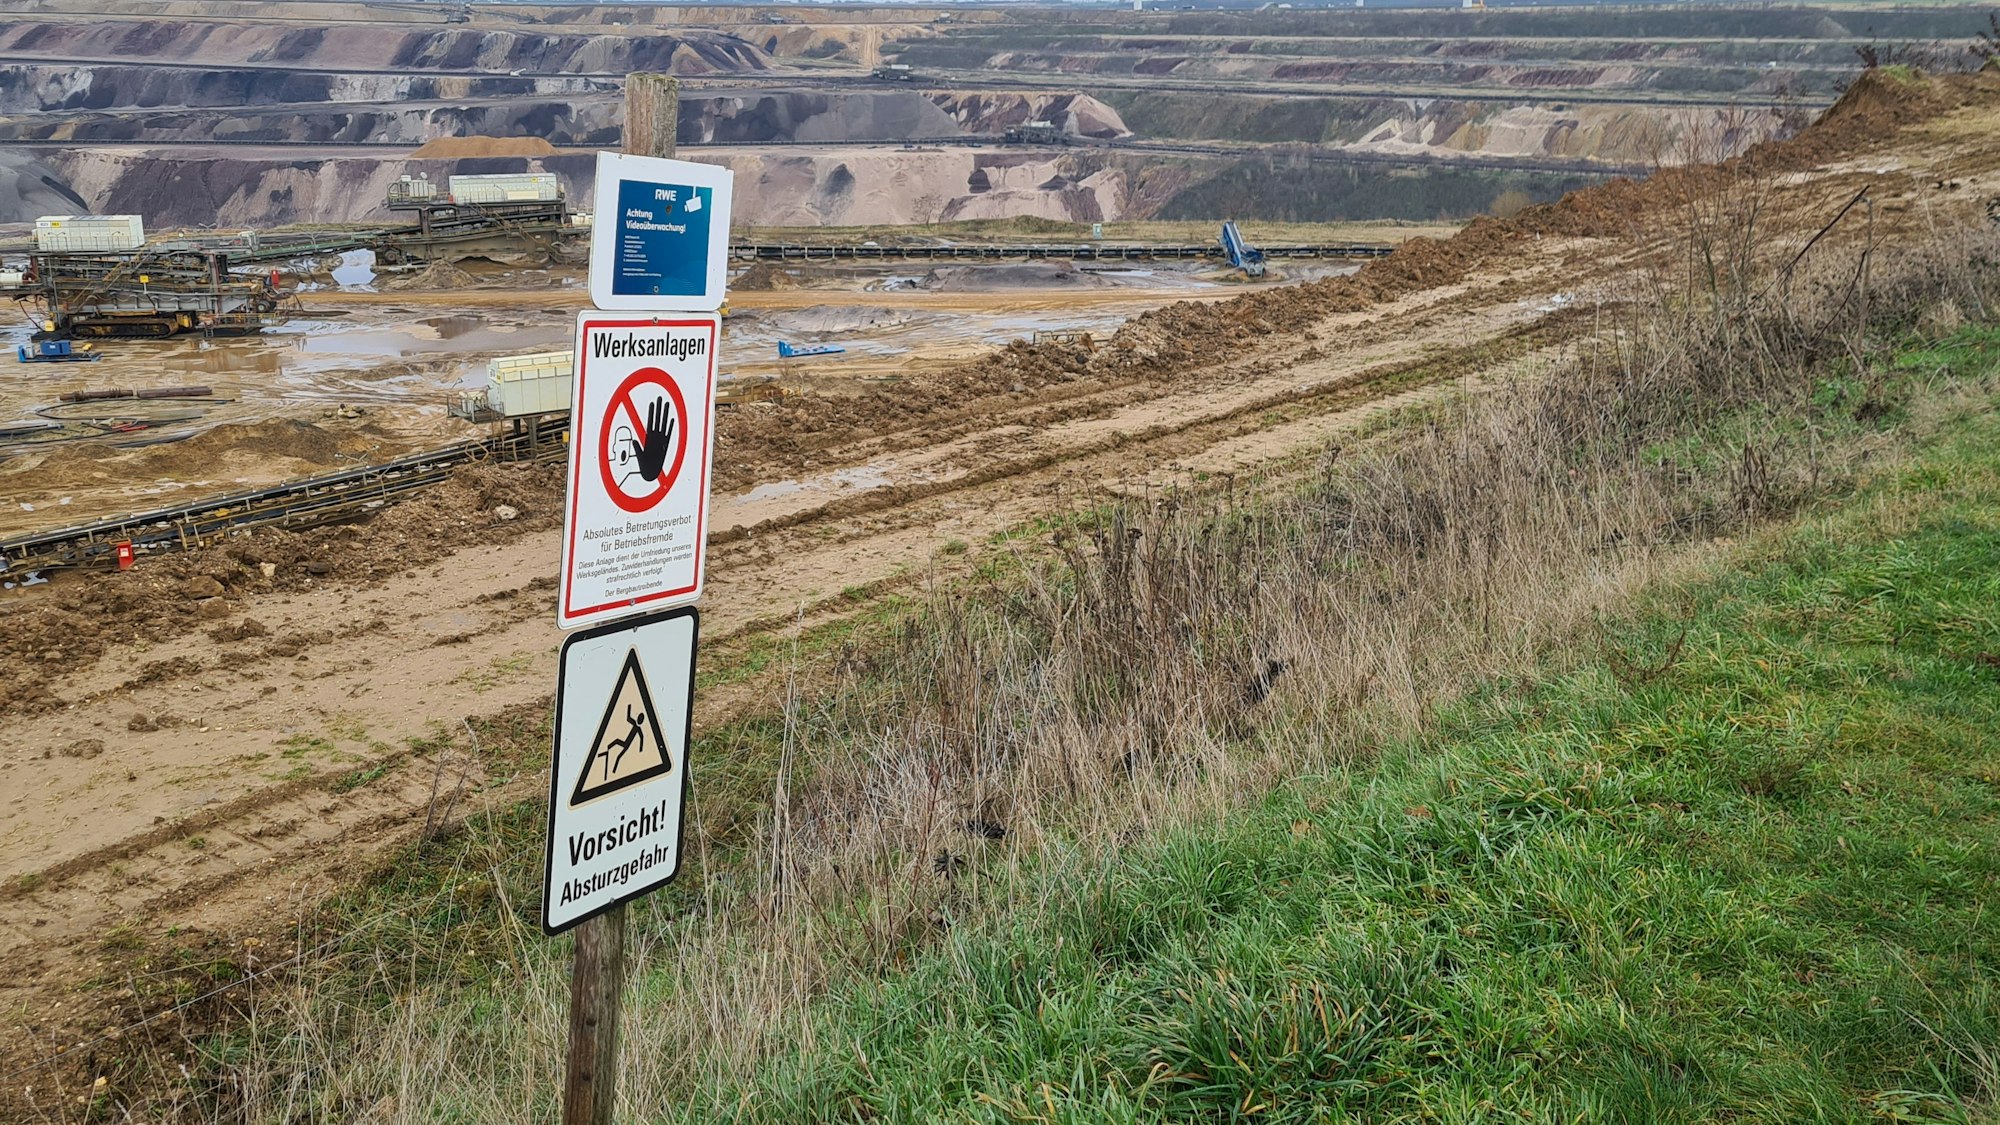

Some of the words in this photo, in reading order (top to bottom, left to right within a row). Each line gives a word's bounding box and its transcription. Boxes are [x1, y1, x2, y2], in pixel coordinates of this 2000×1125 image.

[655, 189, 677, 201] RWE
[626, 208, 653, 220] Achtung
[625, 220, 686, 234] Videoüberwachung!
[594, 331, 705, 361] Werksanlagen
[583, 525, 624, 541] Absolutes
[625, 514, 692, 533] Betretungsverbot
[600, 541, 612, 552] für
[614, 531, 673, 551] Betriebsfremde
[578, 560, 594, 570] Diese
[595, 556, 615, 567] Anlage
[616, 554, 630, 563] dient
[630, 552, 640, 560] der
[640, 546, 671, 558] Umfriedung
[671, 543, 692, 552] unseres
[621, 555, 673, 572] Zuwiderhandlungen
[673, 552, 692, 561] werden
[606, 570, 642, 584] strafrechtlich
[604, 589, 615, 598] Der
[616, 580, 663, 595] Bergbautreibende
[568, 799, 666, 867] Vorsicht!
[560, 843, 669, 907] Absturzgefahr
